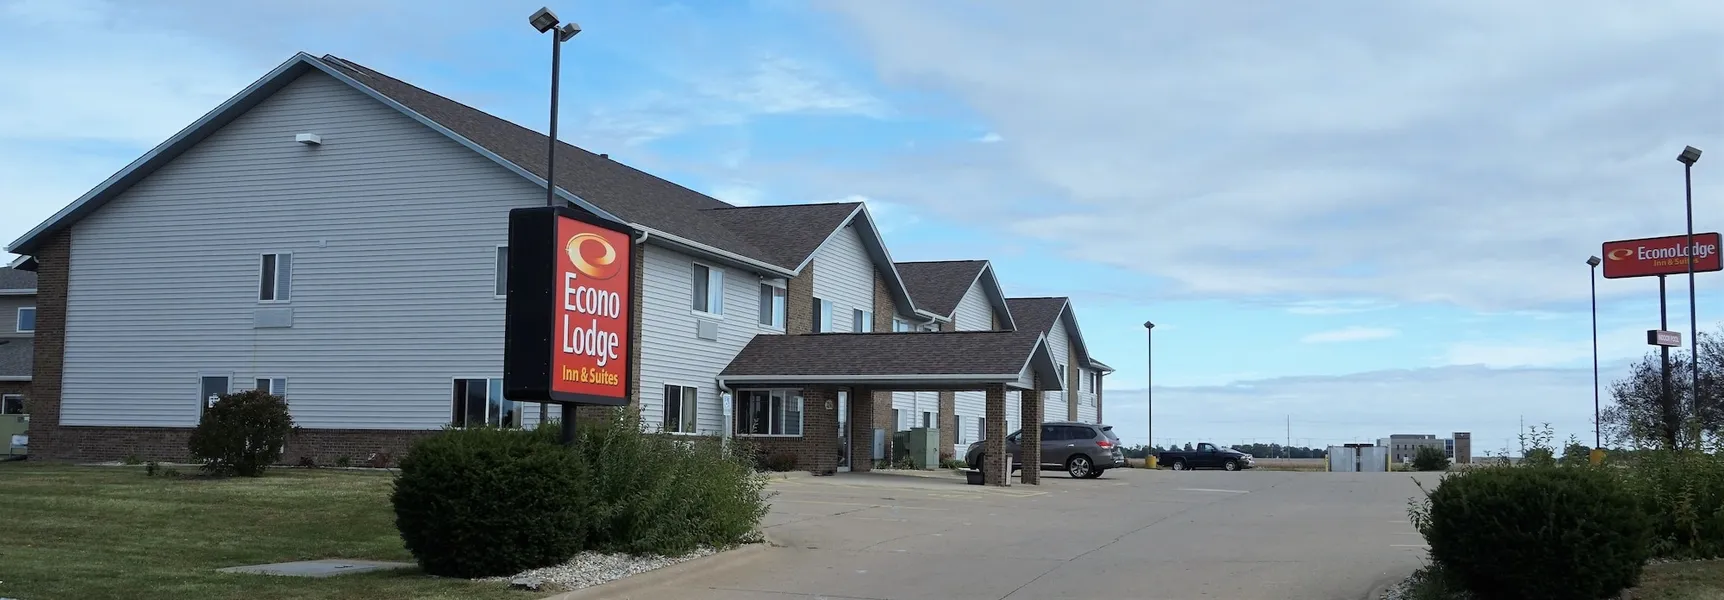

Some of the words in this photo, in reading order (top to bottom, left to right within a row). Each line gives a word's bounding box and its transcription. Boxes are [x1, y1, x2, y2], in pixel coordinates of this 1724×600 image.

[565, 272, 620, 319] Econo
[563, 314, 619, 366] Lodge
[562, 365, 579, 381] Inn
[581, 367, 588, 382] &
[589, 367, 619, 386] Suites
